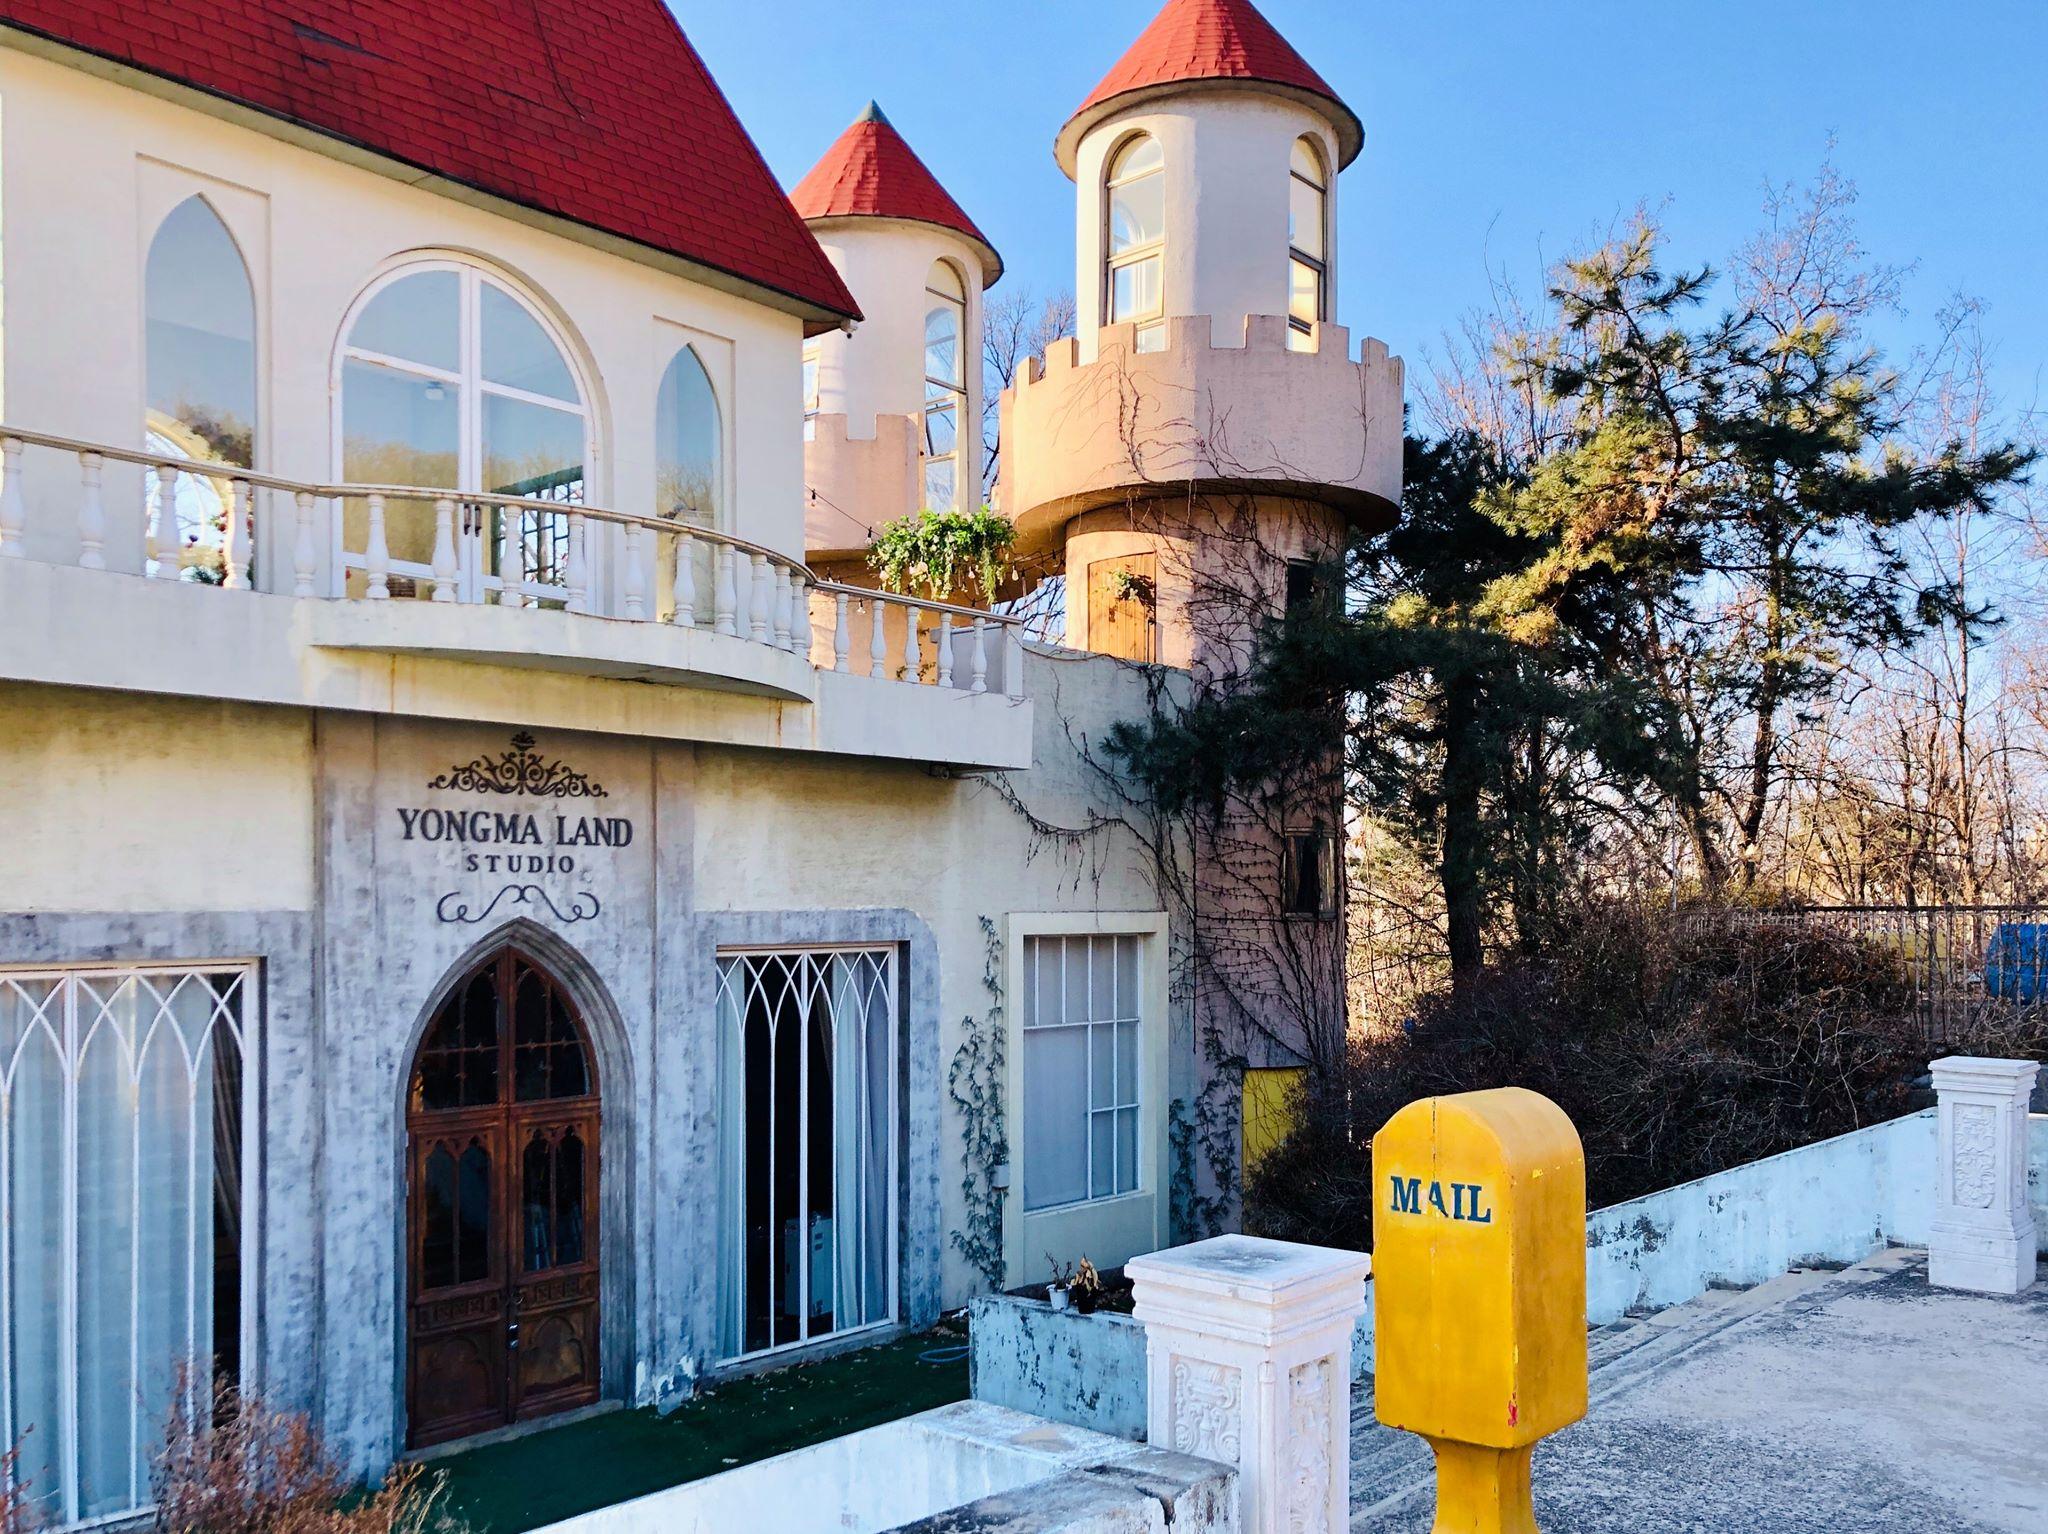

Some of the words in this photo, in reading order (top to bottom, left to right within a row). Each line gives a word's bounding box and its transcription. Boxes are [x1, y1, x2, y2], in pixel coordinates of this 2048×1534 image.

[397, 808, 542, 845] YONGMA
[556, 815, 633, 847] LAND
[466, 854, 575, 873] STUDIO
[1390, 1175, 1491, 1223] MAIL
